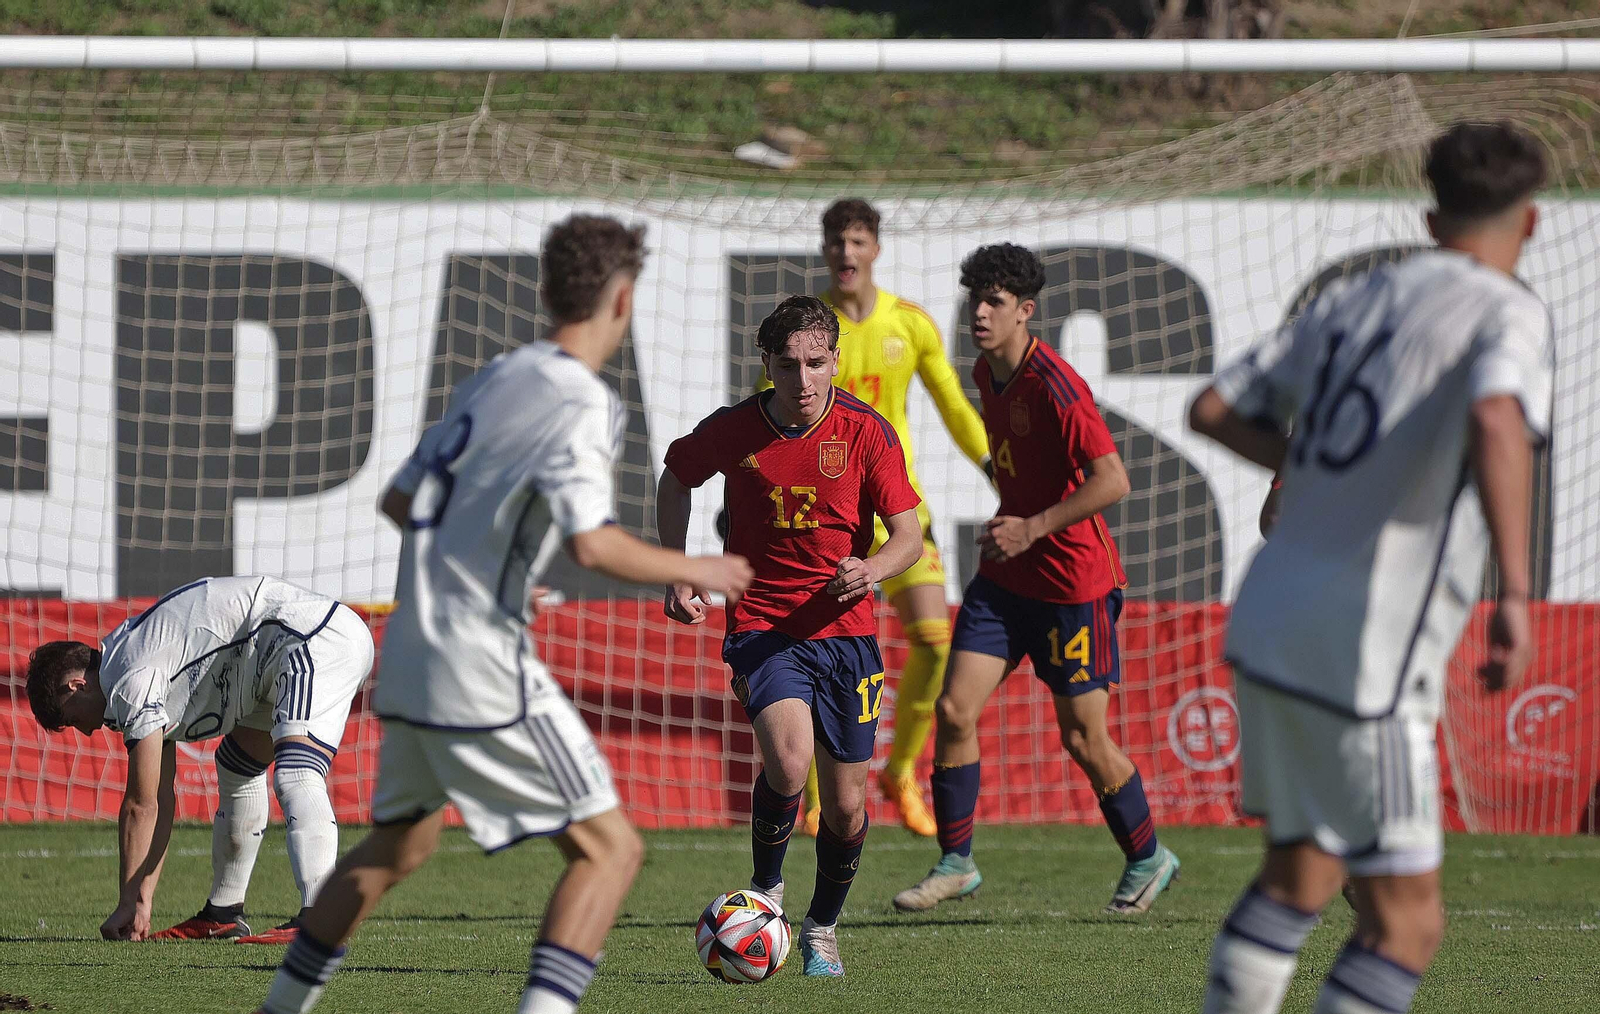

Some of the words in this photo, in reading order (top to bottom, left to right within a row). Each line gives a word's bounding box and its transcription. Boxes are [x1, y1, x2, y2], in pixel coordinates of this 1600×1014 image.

[1293, 328, 1396, 473] 16
[769, 486, 819, 529] 12
[1047, 625, 1090, 667] 14
[856, 672, 885, 724] 12
